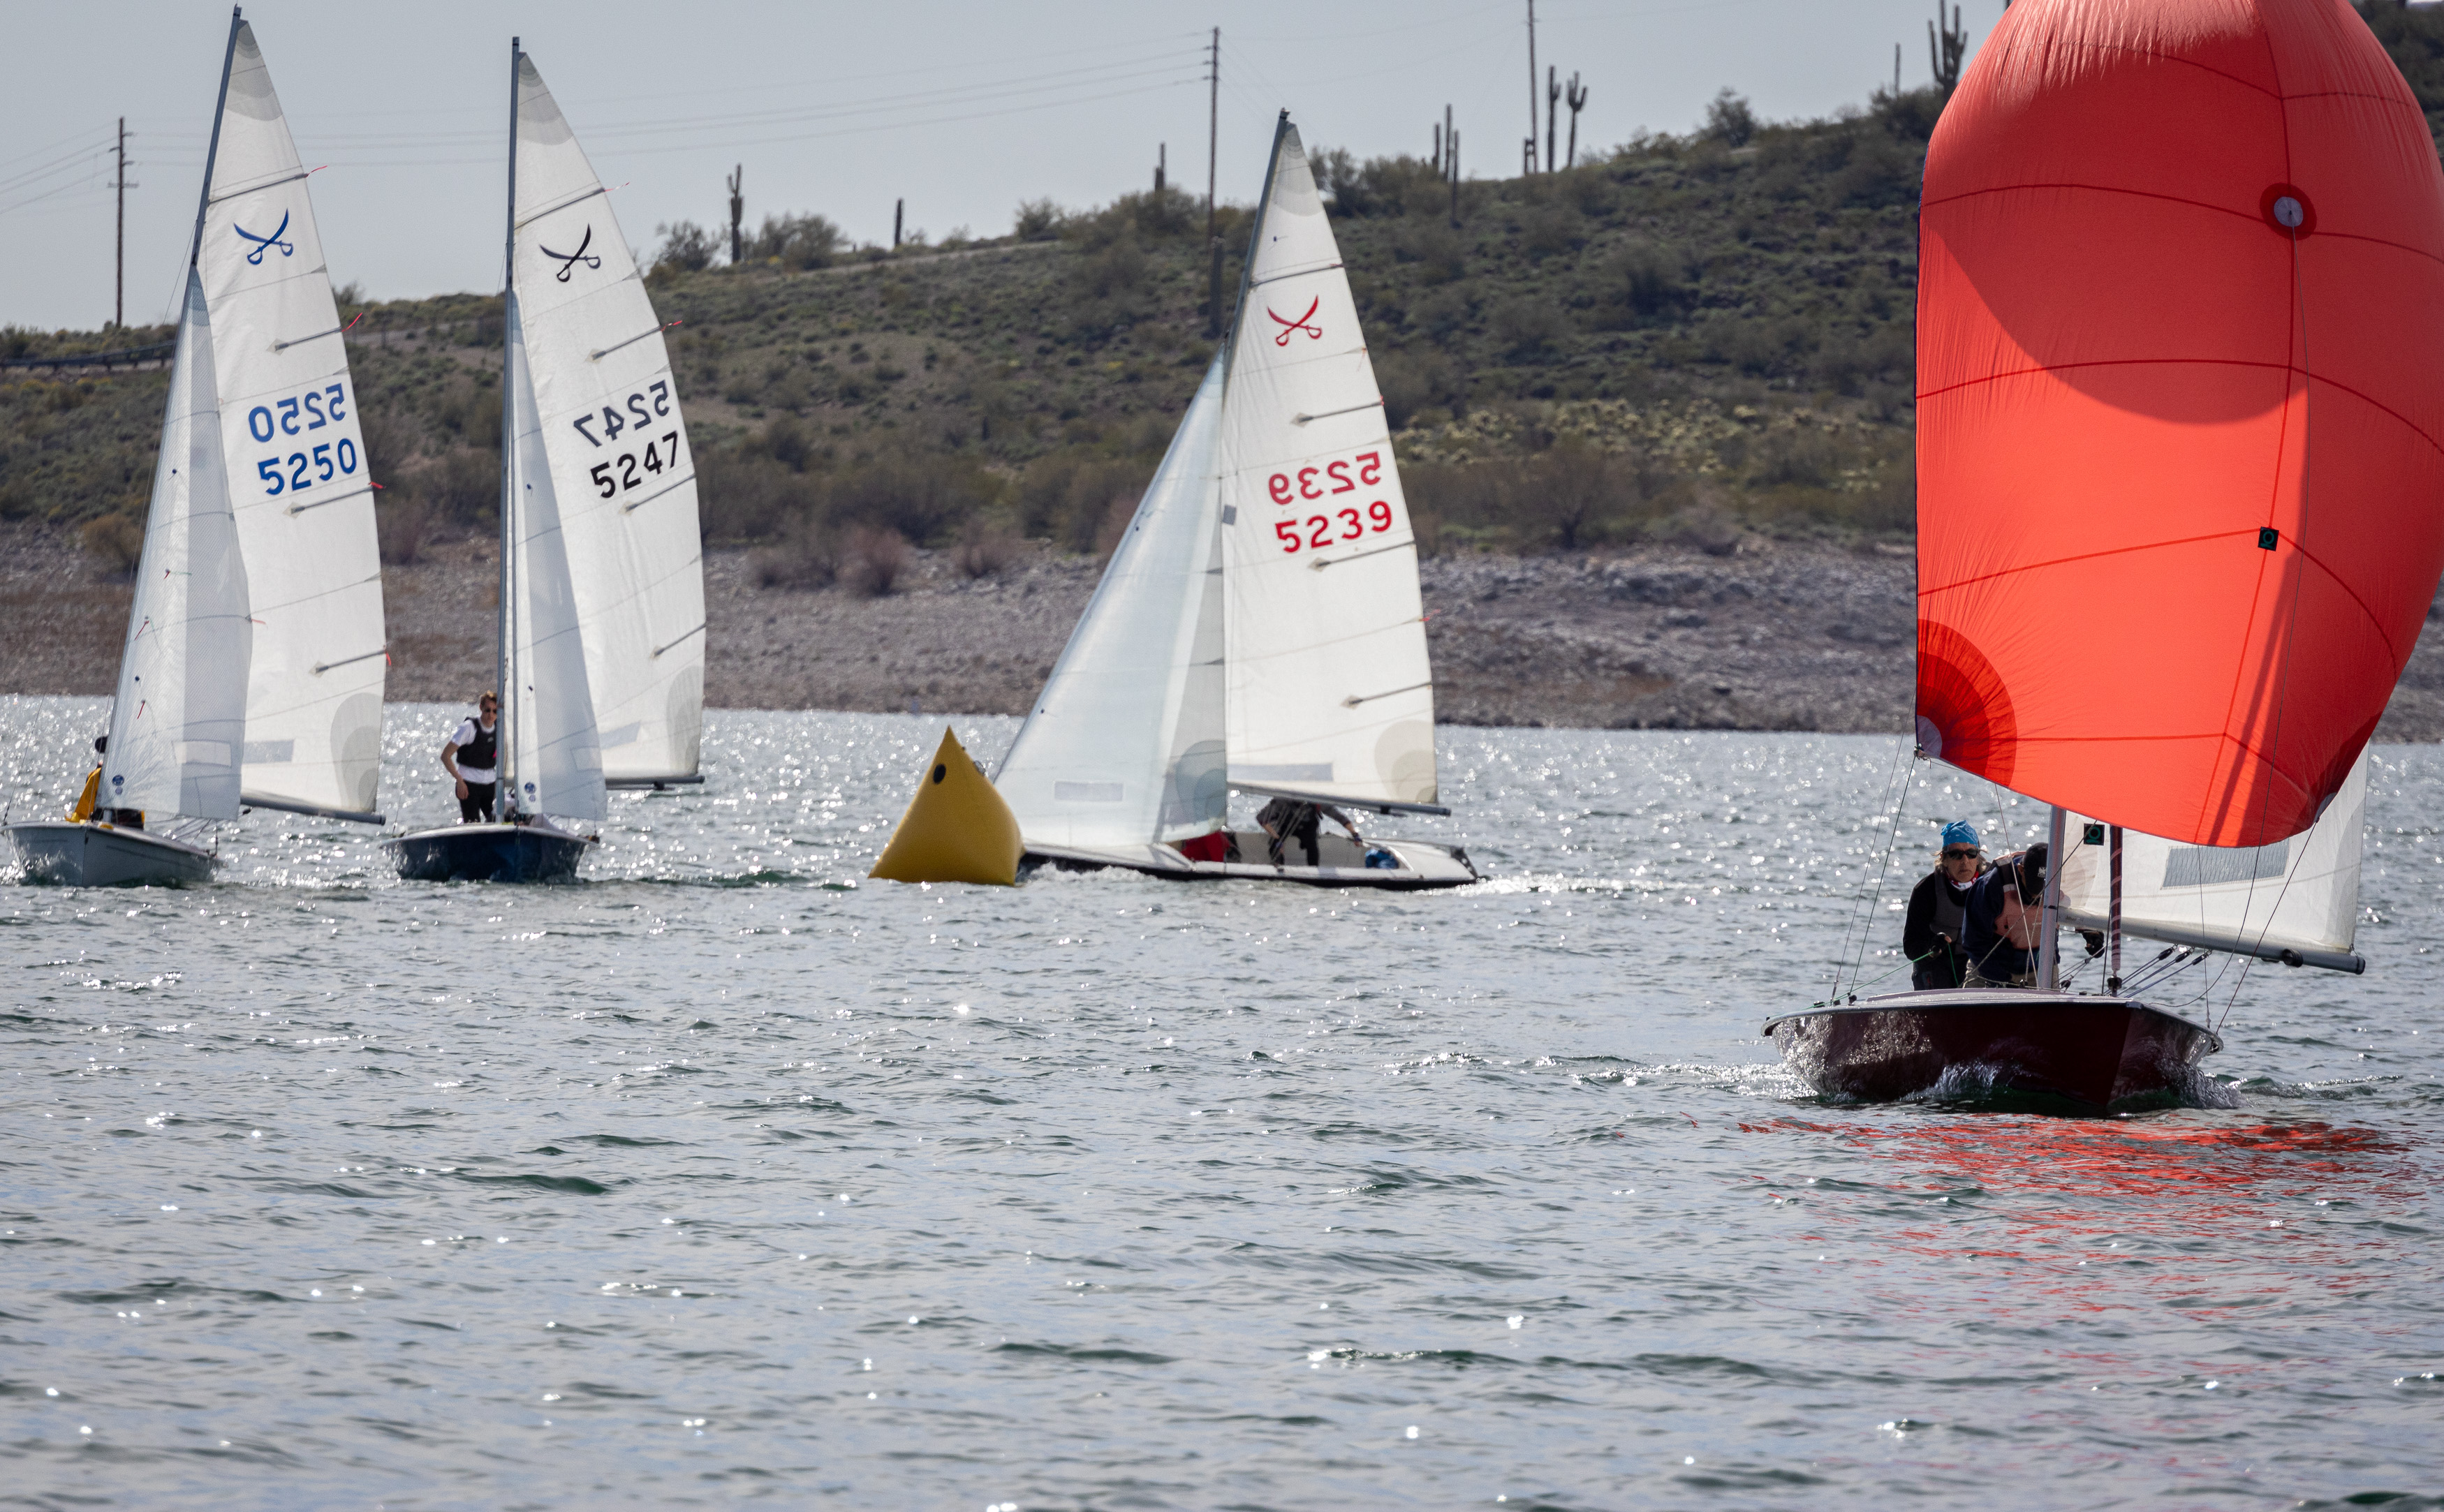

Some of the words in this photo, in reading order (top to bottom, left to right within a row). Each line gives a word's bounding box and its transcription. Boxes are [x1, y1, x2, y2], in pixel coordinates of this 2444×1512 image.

[257, 438, 357, 495] 5250
[590, 430, 679, 498] 5247
[1274, 501, 1392, 553] 5239
